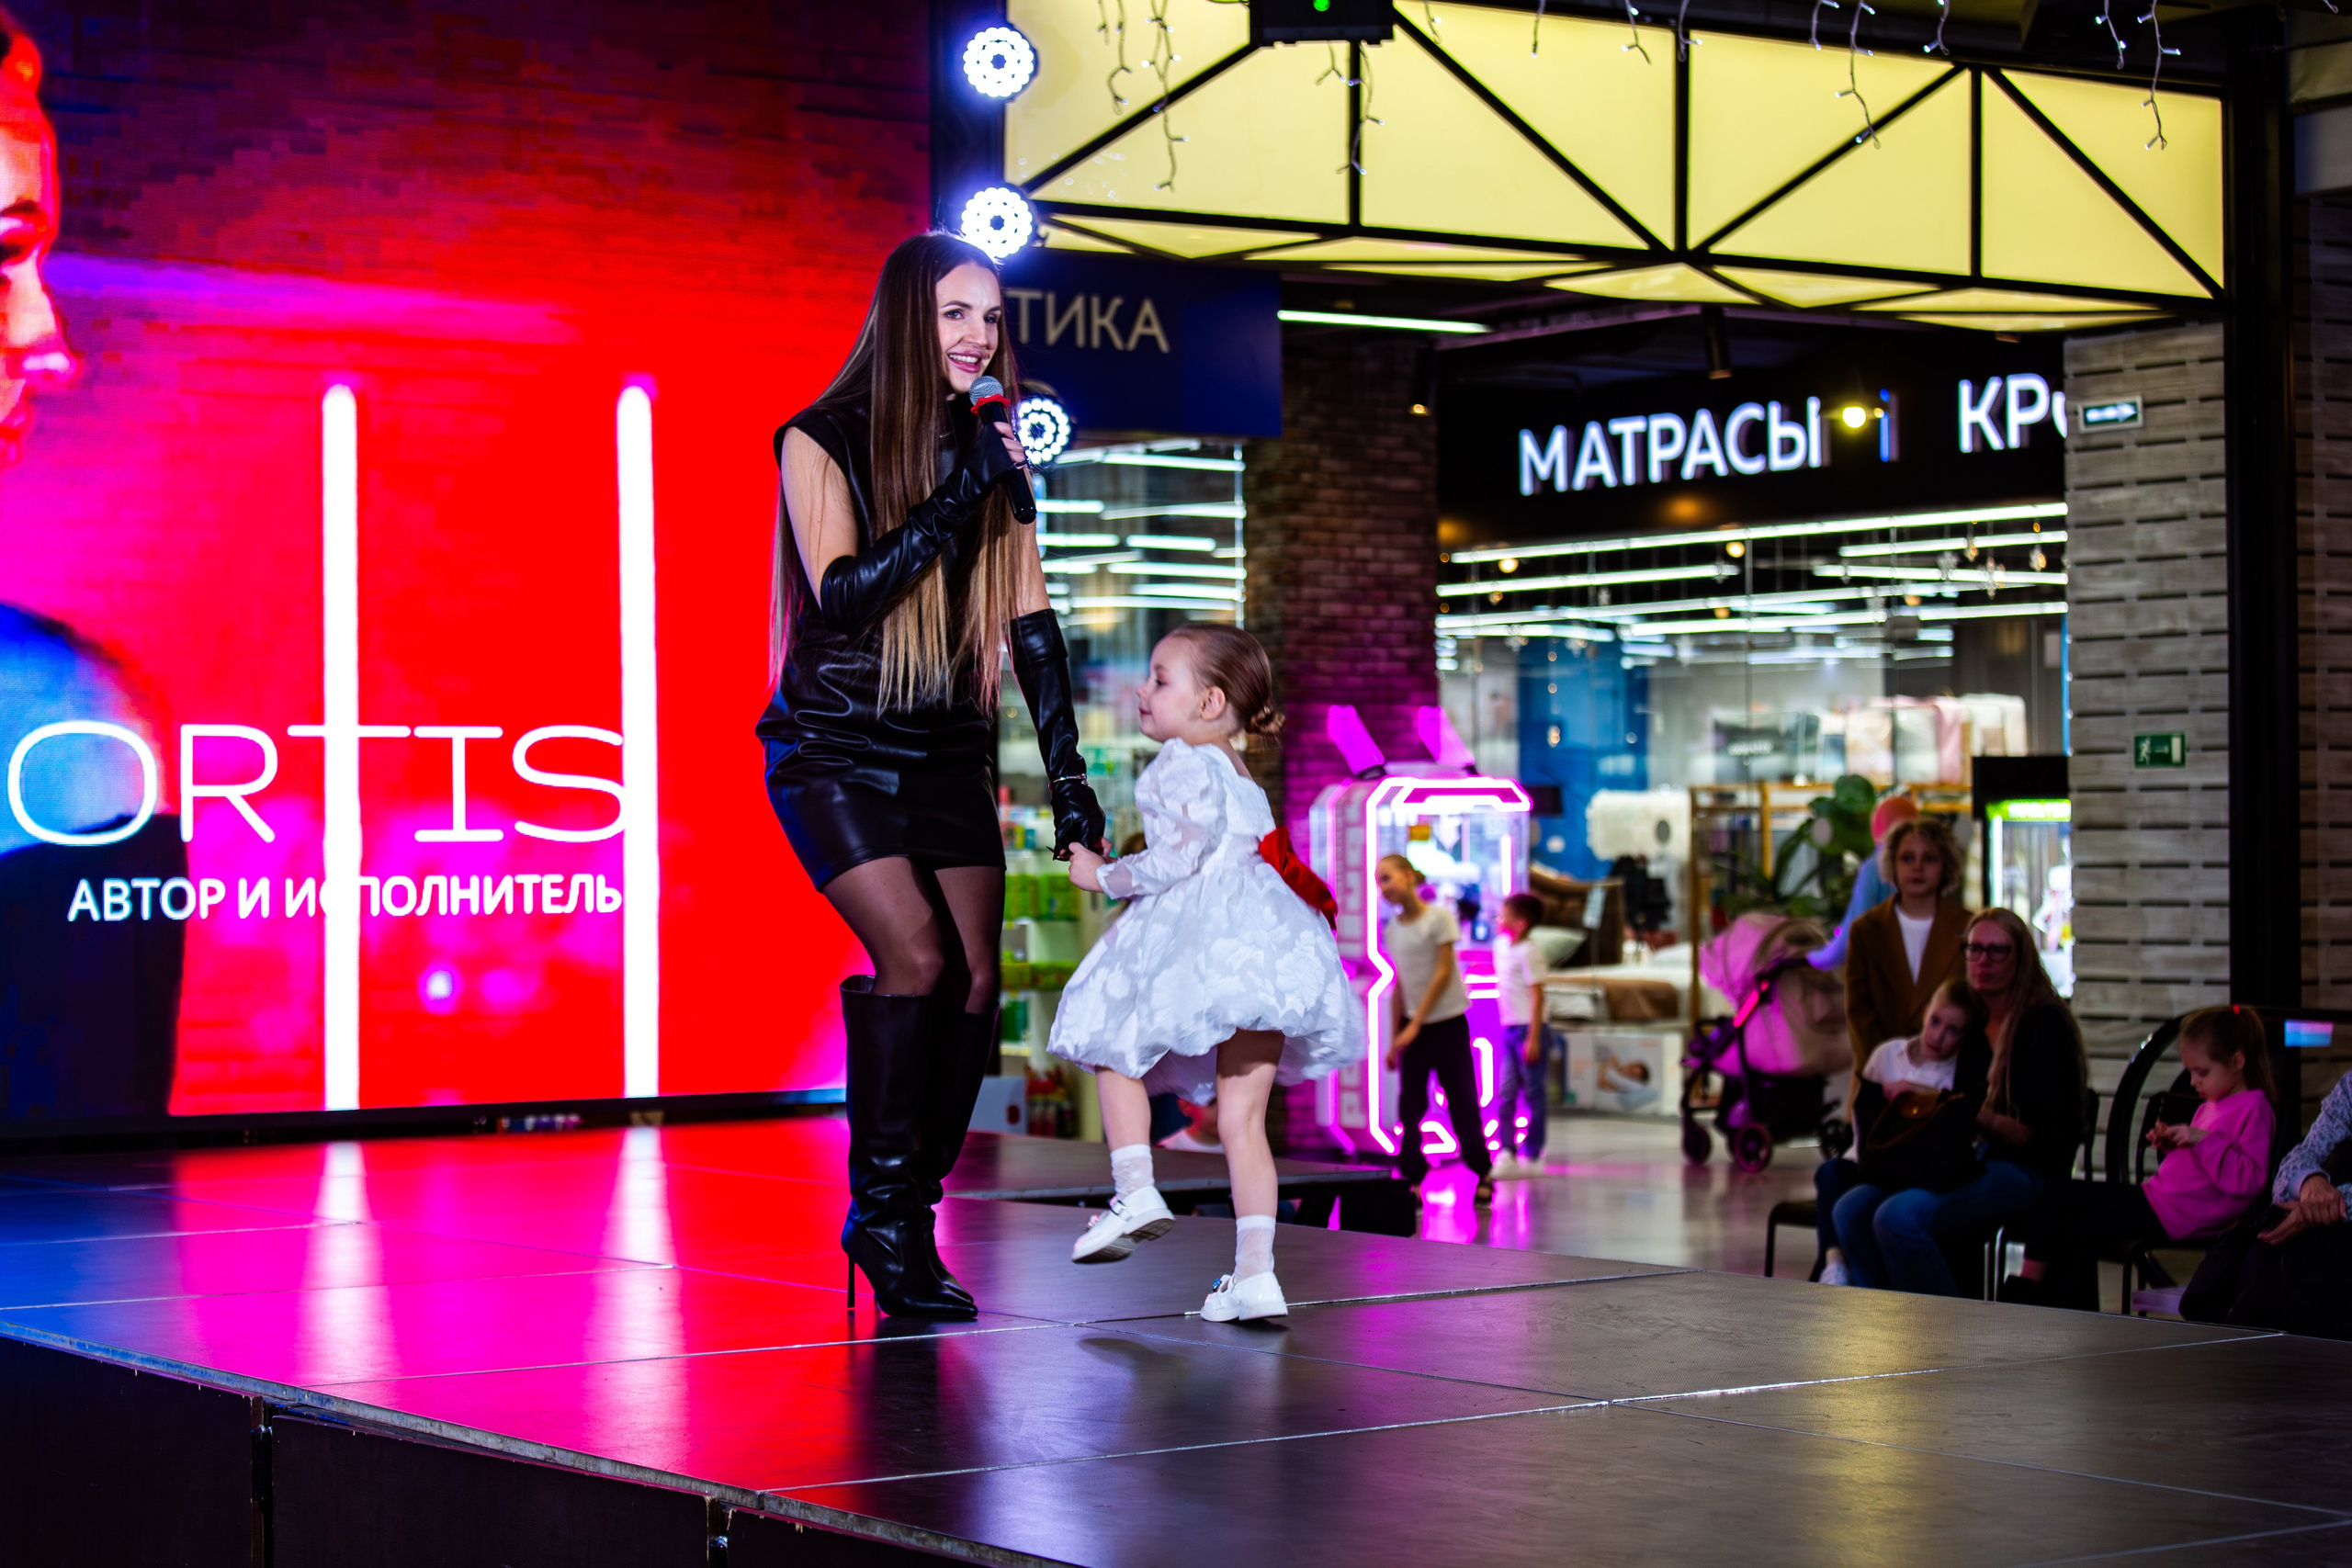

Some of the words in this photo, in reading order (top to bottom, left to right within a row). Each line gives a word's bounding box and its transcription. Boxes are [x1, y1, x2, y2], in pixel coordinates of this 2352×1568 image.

[1005, 288, 1170, 354] ТИКА
[1518, 396, 1822, 496] МАТРАСЫ
[7, 720, 626, 847] ORTIS
[68, 877, 226, 921] АВТОР
[239, 878, 270, 918] И
[285, 874, 623, 918] ИПОЛНИТЕЛЬ
